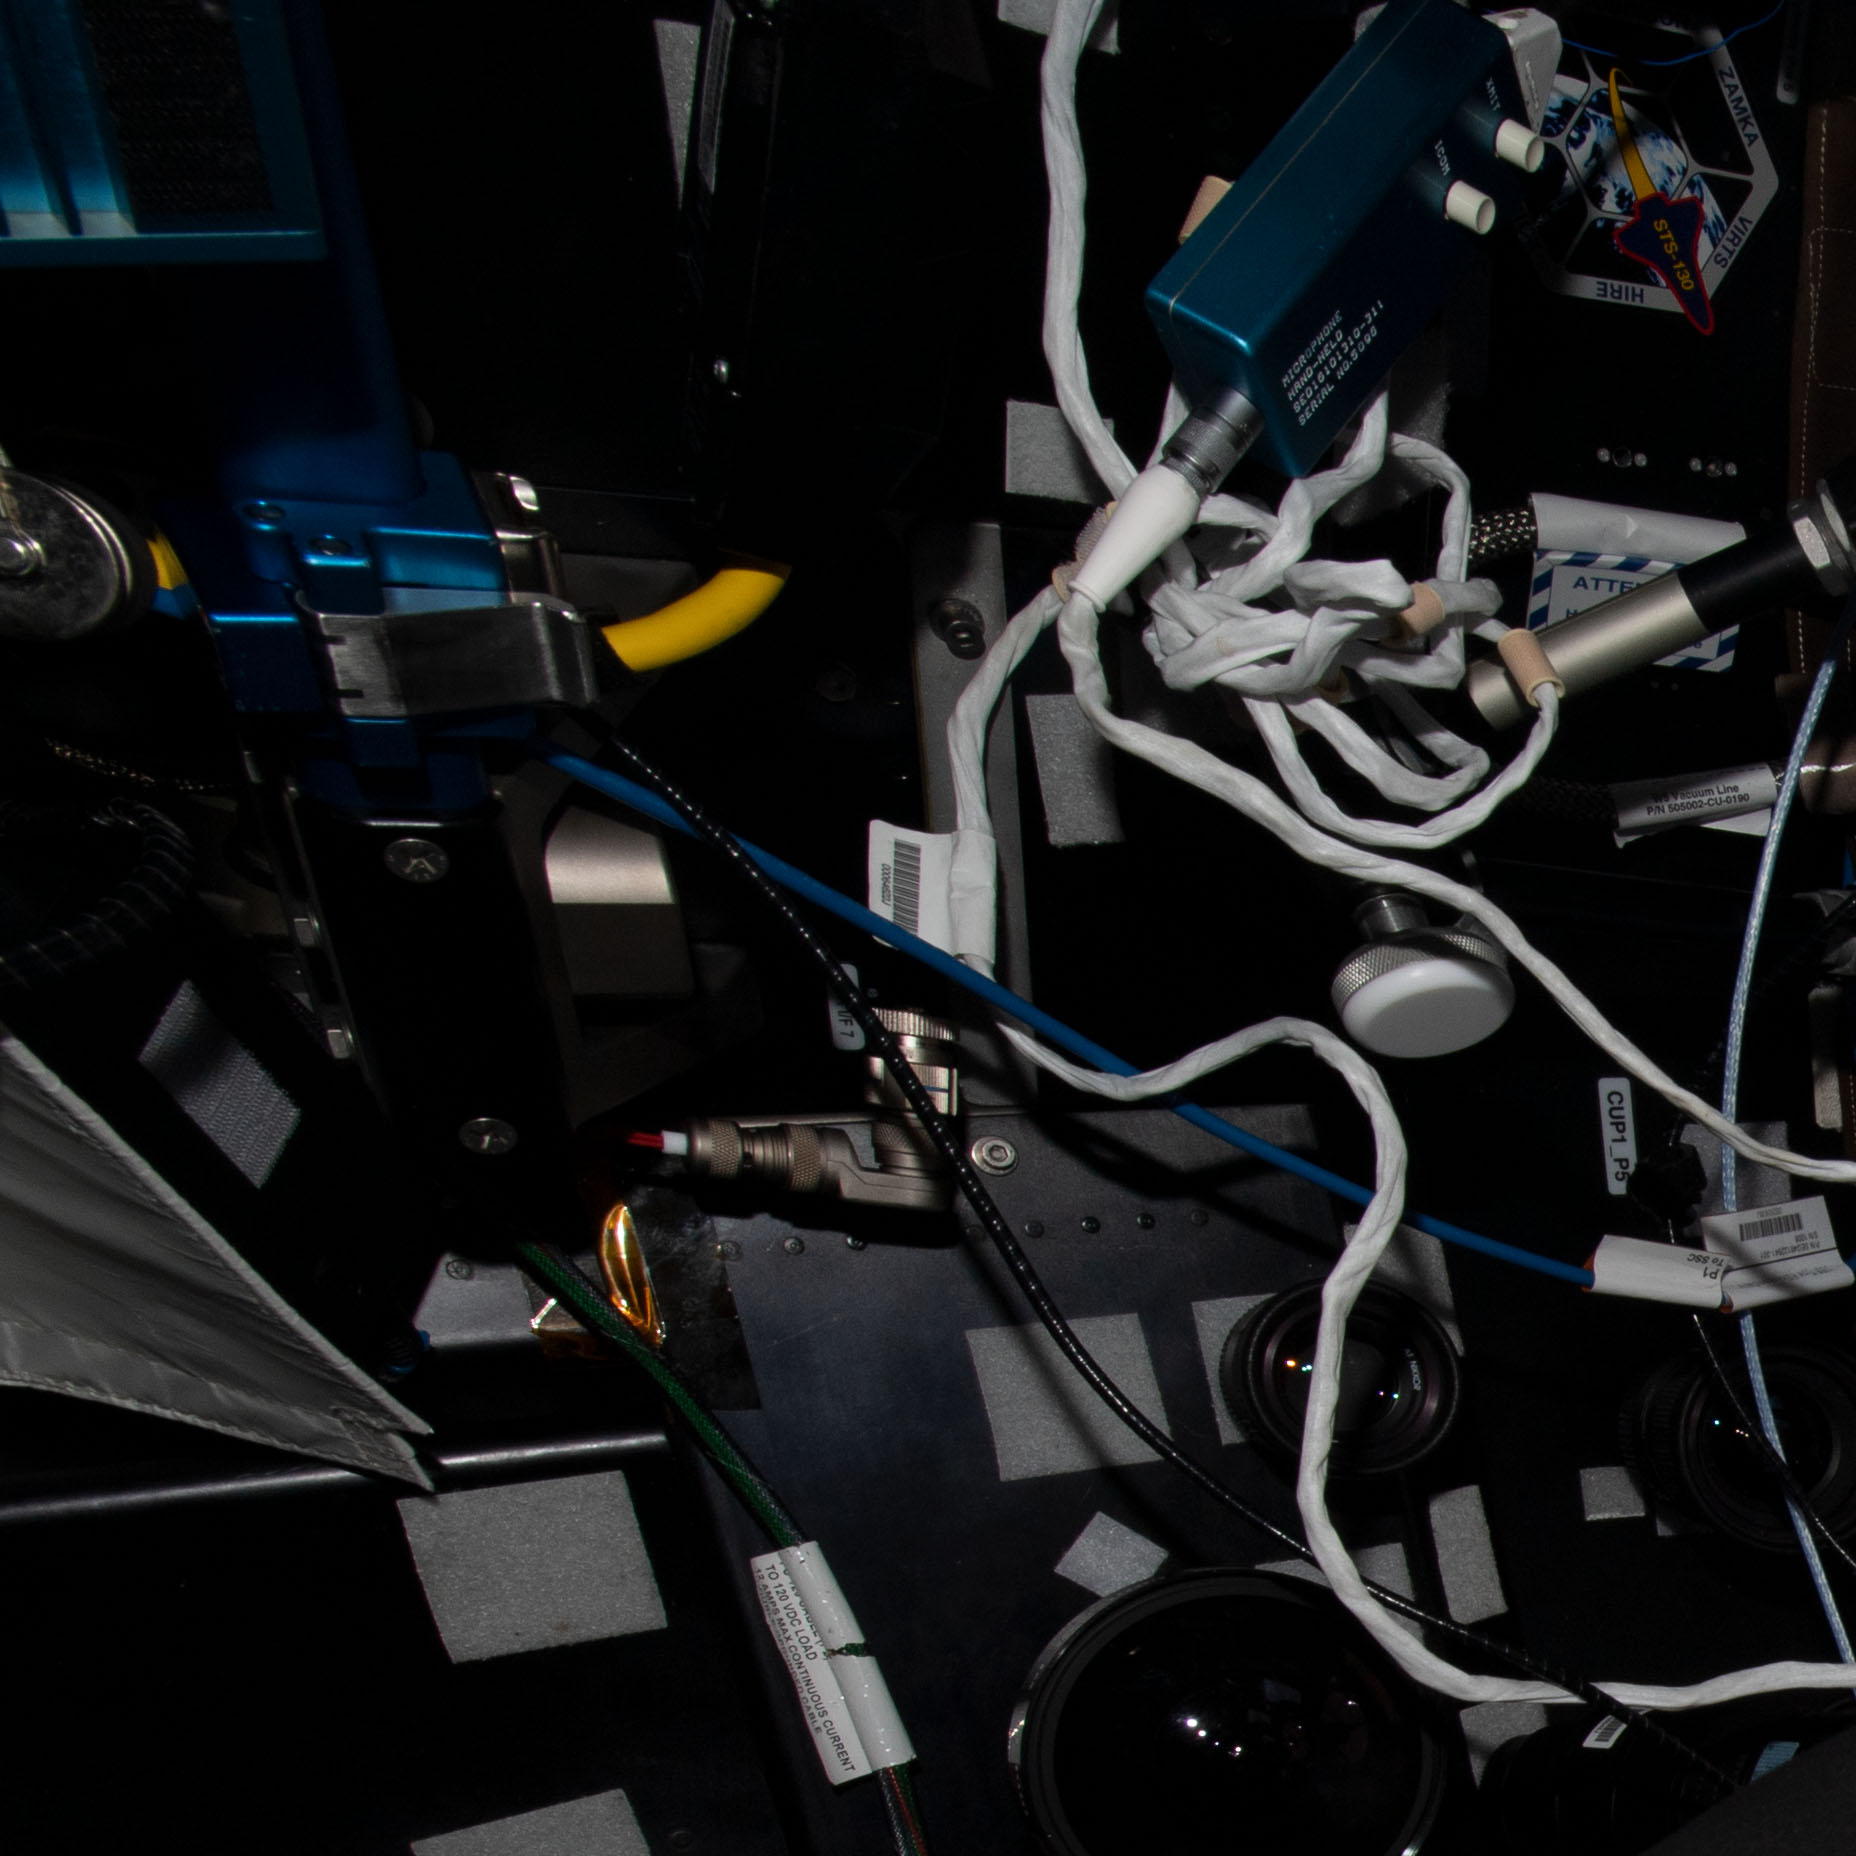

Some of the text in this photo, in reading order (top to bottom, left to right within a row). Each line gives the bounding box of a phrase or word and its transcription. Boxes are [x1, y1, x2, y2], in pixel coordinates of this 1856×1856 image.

[1716, 65, 1760, 148] ZAMKA
[1650, 215, 1698, 294] STS-130
[1711, 213, 1753, 269] VIRTS
[1595, 281, 1645, 304] HIRE
[1281, 307, 1342, 389] MICROPHONE
[1287, 327, 1343, 403] HAND-HELD
[1298, 379, 1333, 427] SERIAL
[1646, 804, 1665, 815] P/N
[1670, 787, 1714, 801] Vacuum
[1715, 782, 1739, 795] Line
[839, 1030, 854, 1038] 7
[1606, 1090, 1630, 1182] CUP1_P5
[1686, 1251, 1724, 1266] To SSC
[1701, 1265, 1719, 1279] P1
[763, 1562, 819, 1663] TO 120 VDC LOAD
[760, 1582, 781, 1615] AMPS
[774, 1616, 793, 1643] MAX
[787, 1643, 829, 1719] CONTINUOUS
[820, 1717, 856, 1773] CURRENT
